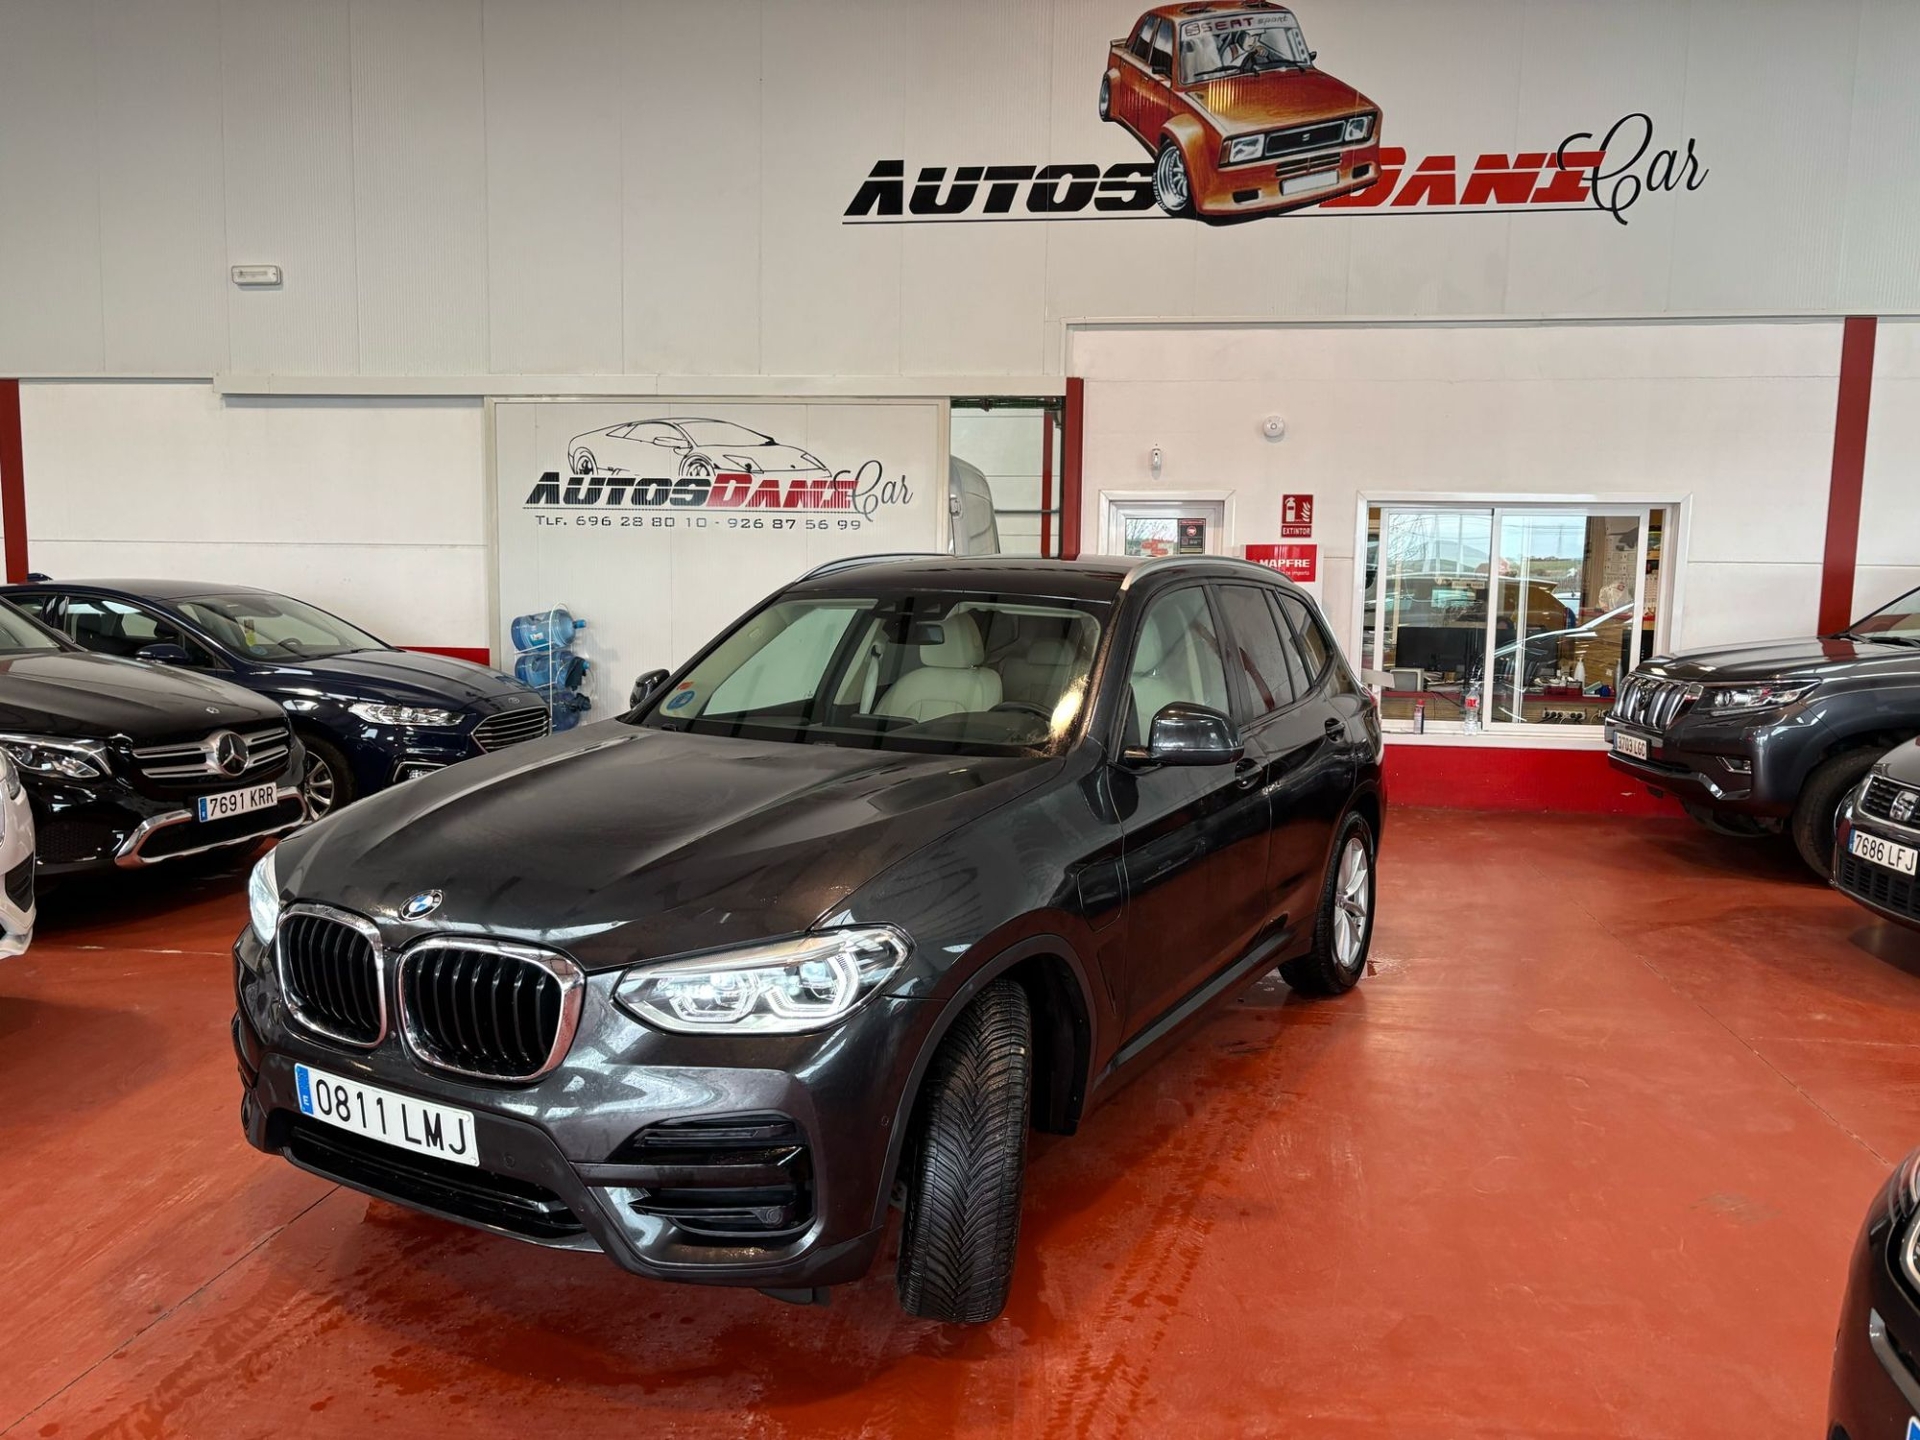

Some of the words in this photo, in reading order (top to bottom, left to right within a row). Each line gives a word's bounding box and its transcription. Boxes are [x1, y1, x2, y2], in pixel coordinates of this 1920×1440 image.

[843, 160, 1161, 216] AUTOS
[576, 516, 612, 526] 696
[620, 516, 644, 527] 28
[651, 517, 676, 528] 80
[685, 517, 708, 528] 10
[727, 518, 764, 529] 926
[772, 518, 796, 530] 87
[805, 518, 829, 530] 56
[837, 519, 861, 531] 99
[1282, 527, 1311, 535] EXTINTOR
[1259, 558, 1311, 568] MAPFRE
[209, 792, 245, 817] 7691
[250, 786, 274, 808] KRR
[1855, 833, 1885, 862] 7686
[1888, 845, 1915, 871] LFJ
[316, 1079, 387, 1135] 0811
[401, 1103, 466, 1155] LMJ
